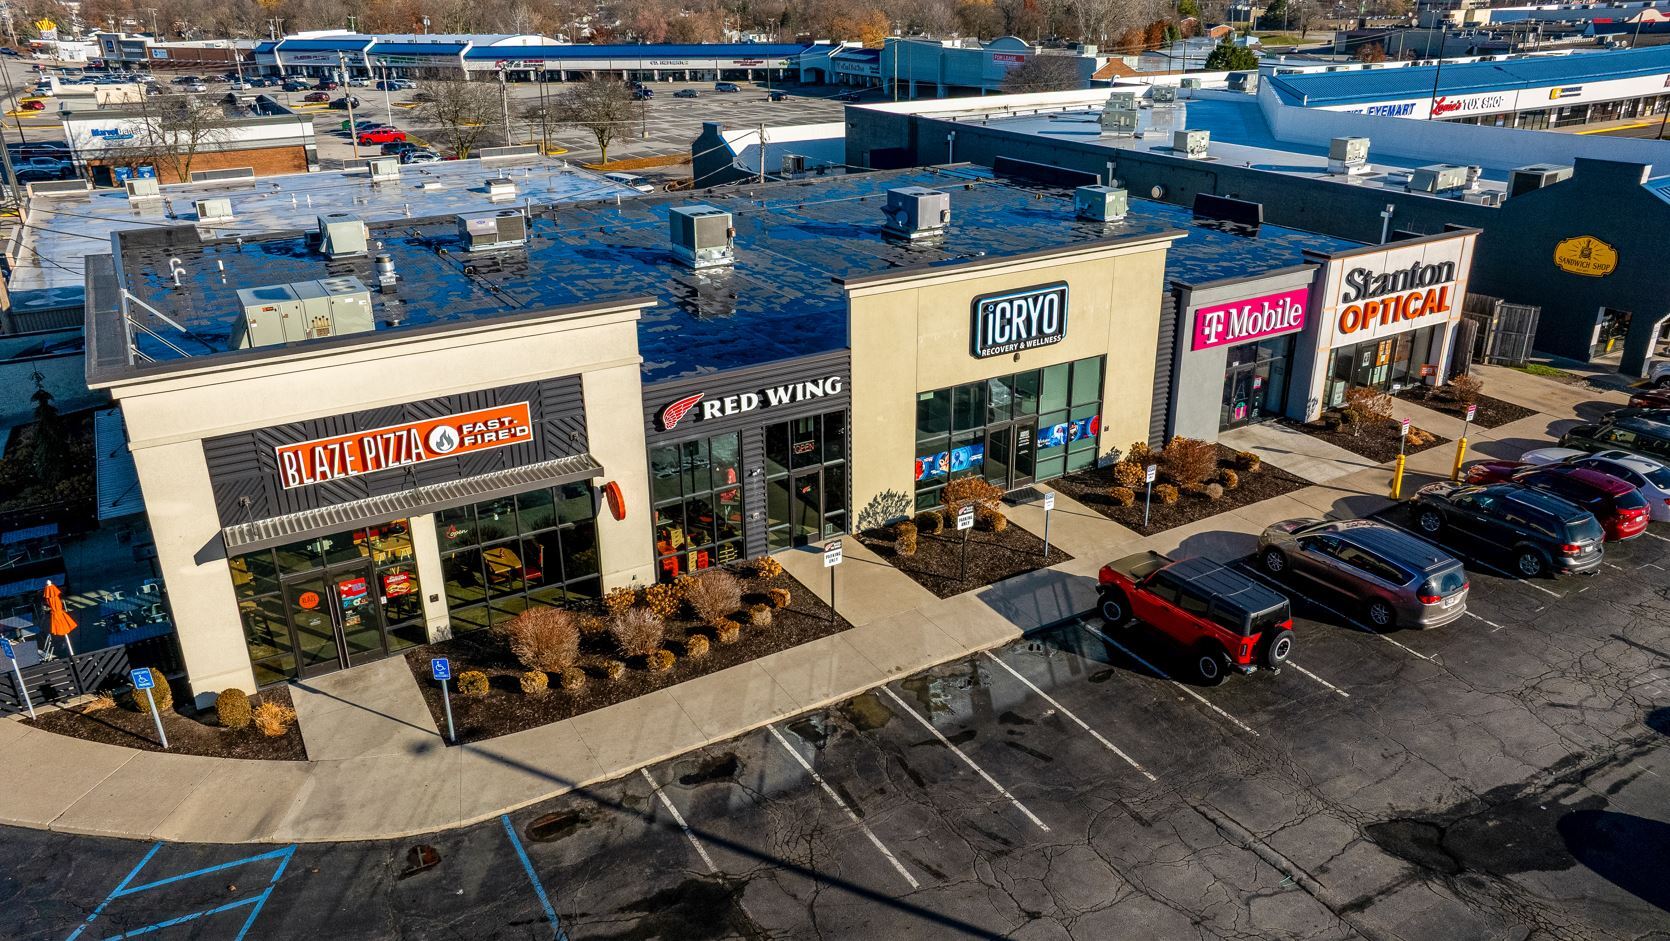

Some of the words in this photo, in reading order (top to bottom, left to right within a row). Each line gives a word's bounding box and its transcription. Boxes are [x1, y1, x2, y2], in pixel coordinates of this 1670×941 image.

[1368, 103, 1417, 116] EYEMART
[1463, 97, 1480, 110] TUX
[1558, 256, 1590, 269] SANDWICH
[1592, 262, 1611, 271] SHOP
[1342, 261, 1456, 304] Stanton
[1225, 297, 1303, 340] Mobile
[1339, 286, 1450, 334] OPTICAL
[981, 342, 1018, 357] RECOVERY
[1019, 341, 1026, 349] &
[1026, 334, 1062, 348] WELLNESS
[703, 392, 759, 420] RED
[765, 376, 843, 407] WING
[463, 426, 529, 447] FIRE'D
[795, 441, 815, 453] OPEN
[283, 441, 358, 487] BLAZE
[363, 428, 427, 471] PIZZA
[959, 515, 973, 523] PARKING
[450, 529, 469, 538] open
[825, 551, 841, 560] PARKING
